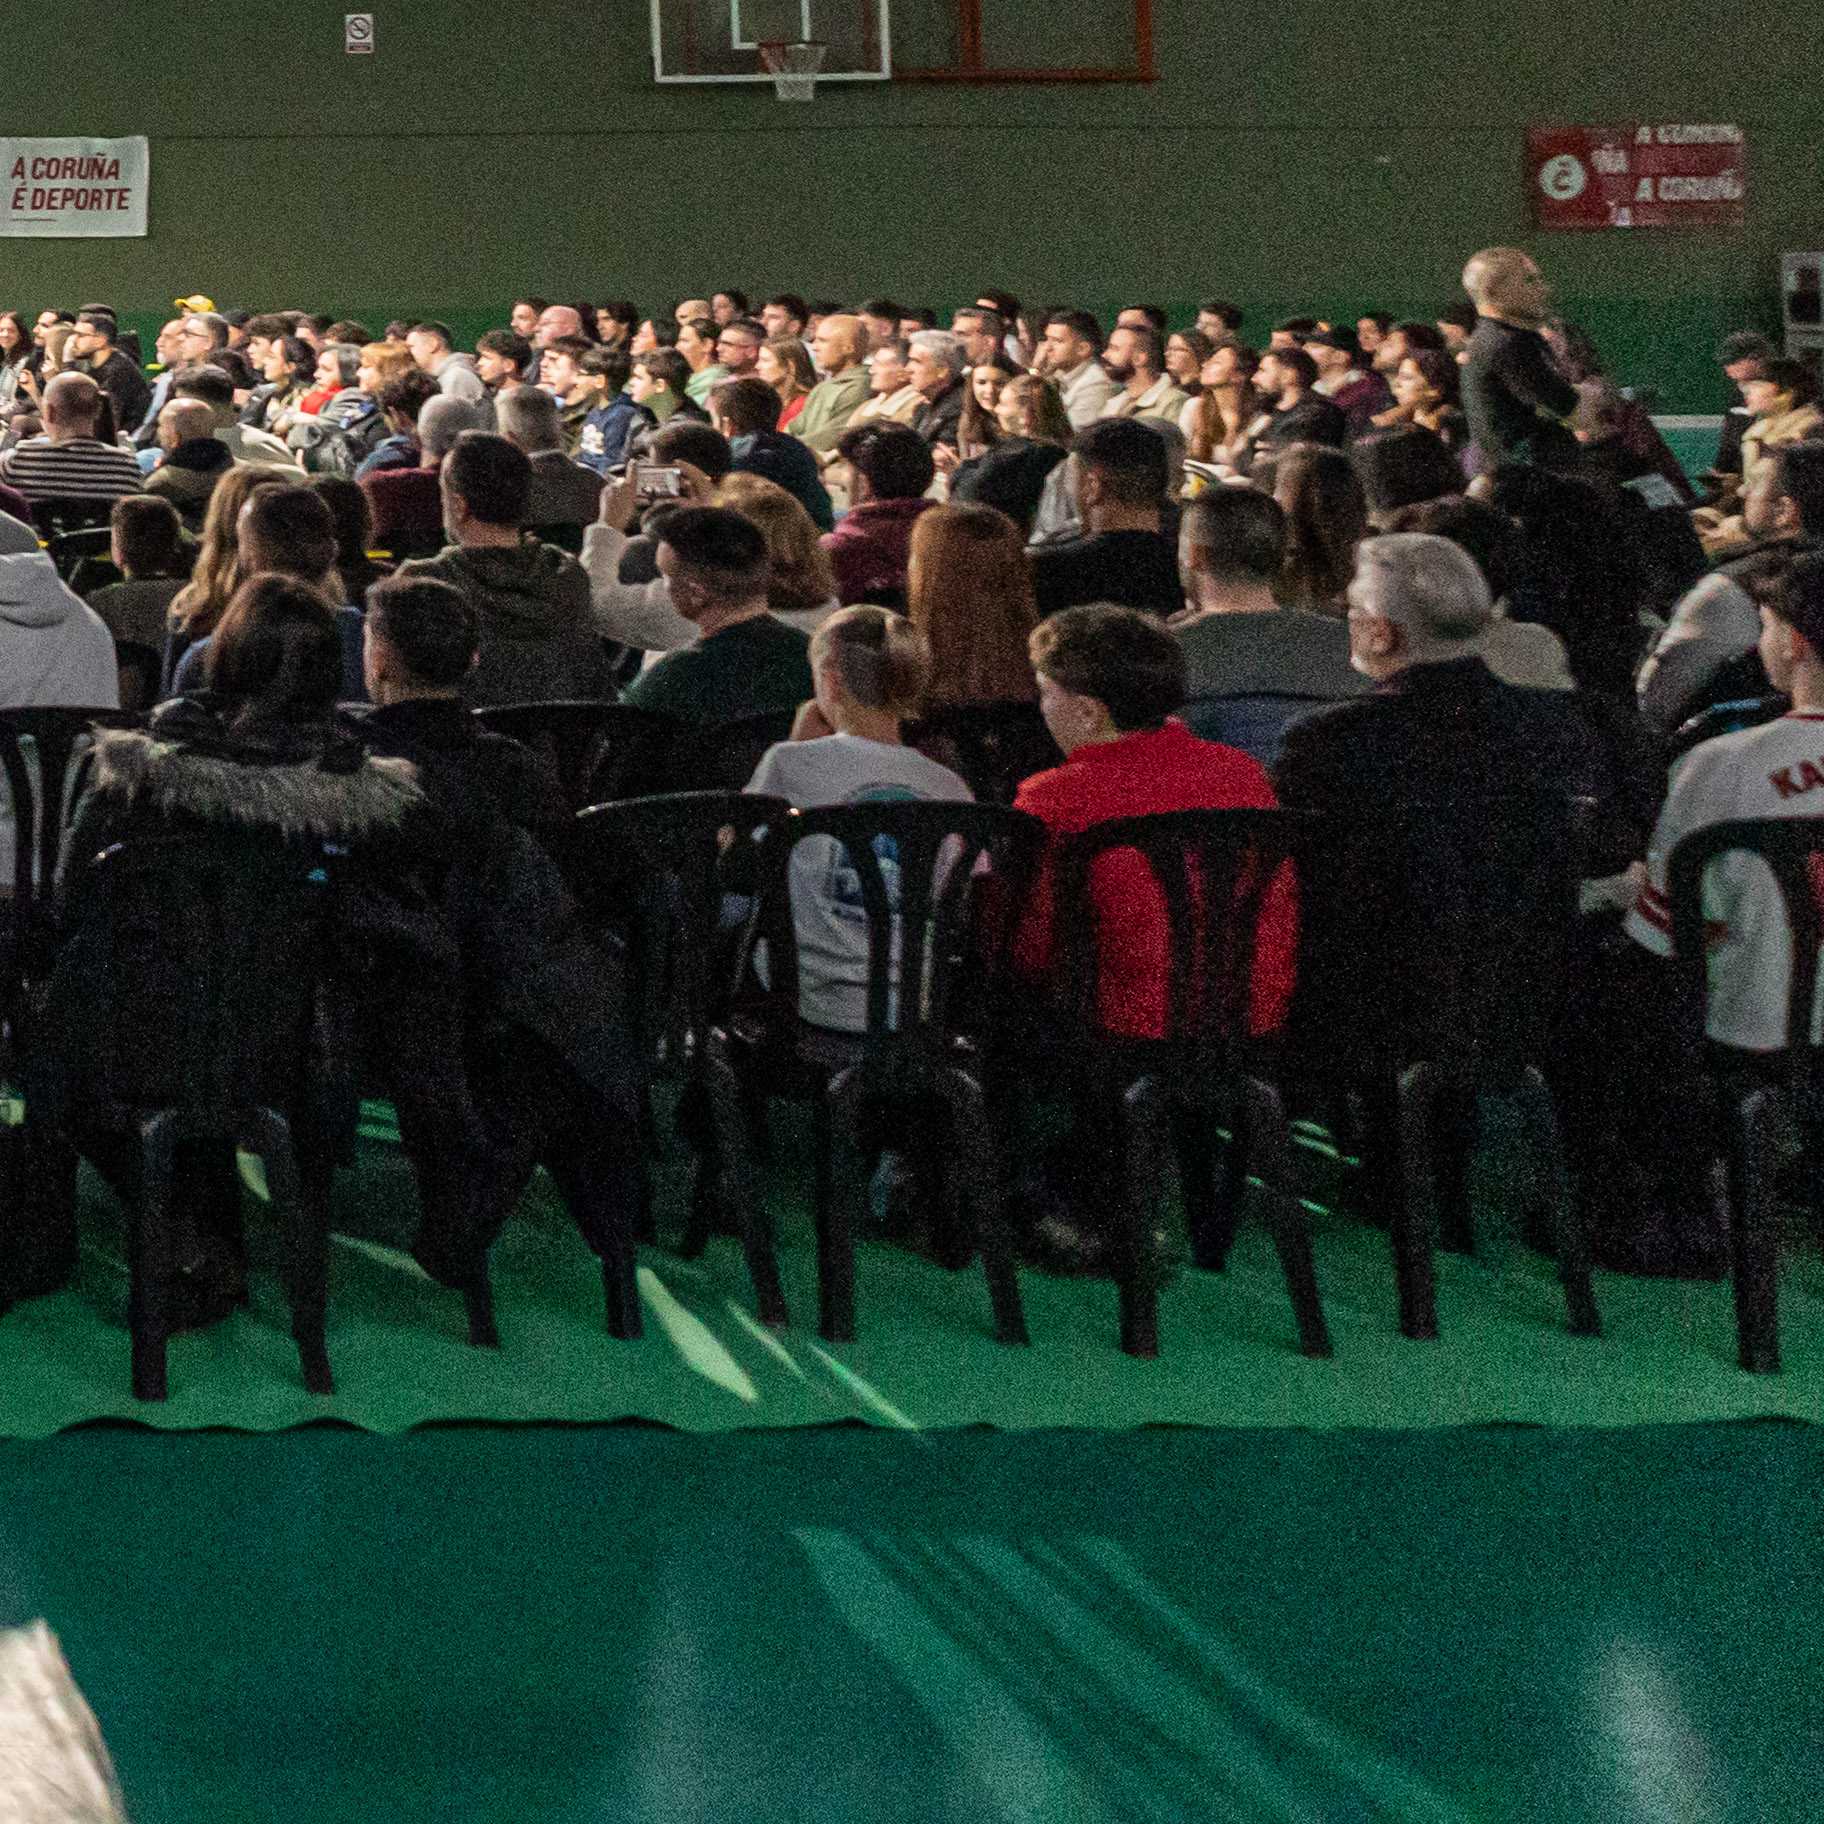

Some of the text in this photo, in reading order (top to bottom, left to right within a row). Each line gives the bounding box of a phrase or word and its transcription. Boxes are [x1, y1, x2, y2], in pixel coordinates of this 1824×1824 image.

[11, 152, 120, 181] A CORUÑA
[11, 181, 132, 211] É DEPORTE
